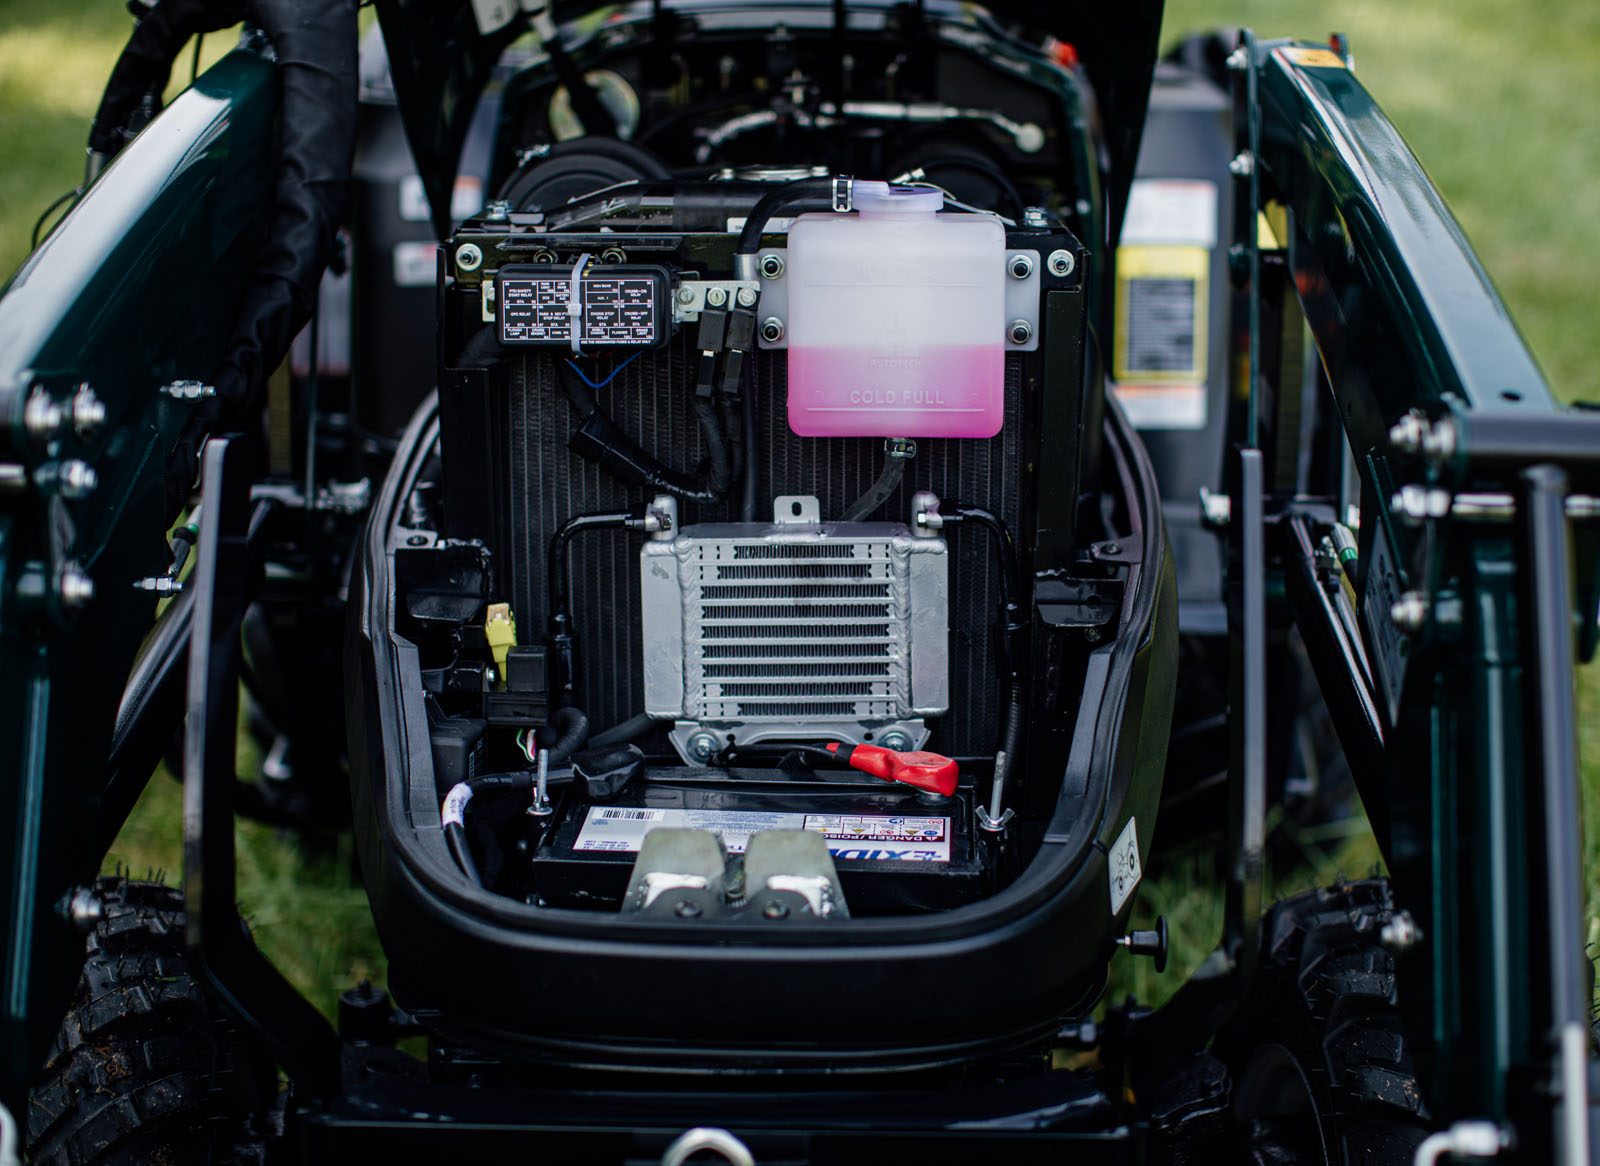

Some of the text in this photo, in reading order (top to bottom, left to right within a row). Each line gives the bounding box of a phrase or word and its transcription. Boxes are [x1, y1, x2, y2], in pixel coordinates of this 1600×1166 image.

[871, 360, 920, 368] AUTOTECH
[850, 390, 944, 404] COLD FULL
